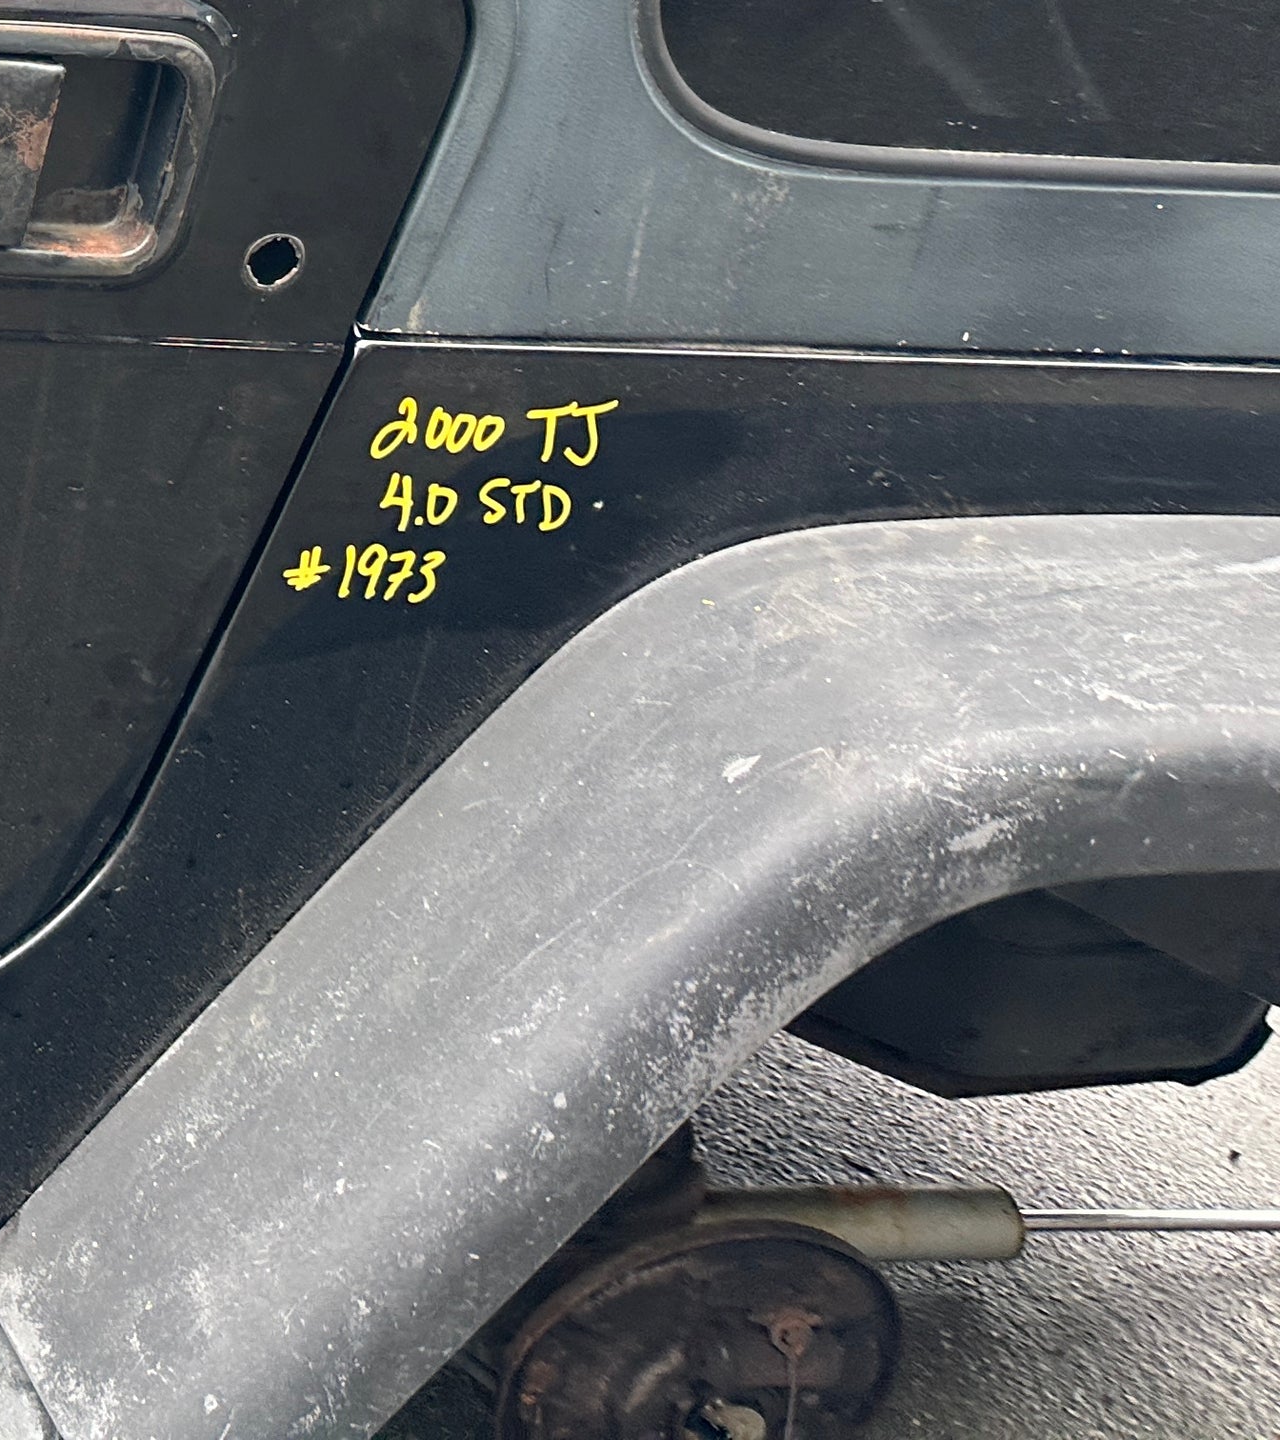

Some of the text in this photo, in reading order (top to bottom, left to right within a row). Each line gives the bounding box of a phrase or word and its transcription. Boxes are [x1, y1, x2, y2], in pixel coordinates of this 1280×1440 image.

[370, 397, 620, 467] 2000 TJ
[379, 472, 572, 533] 4.0 STD
[282, 542, 447, 604] #1973
